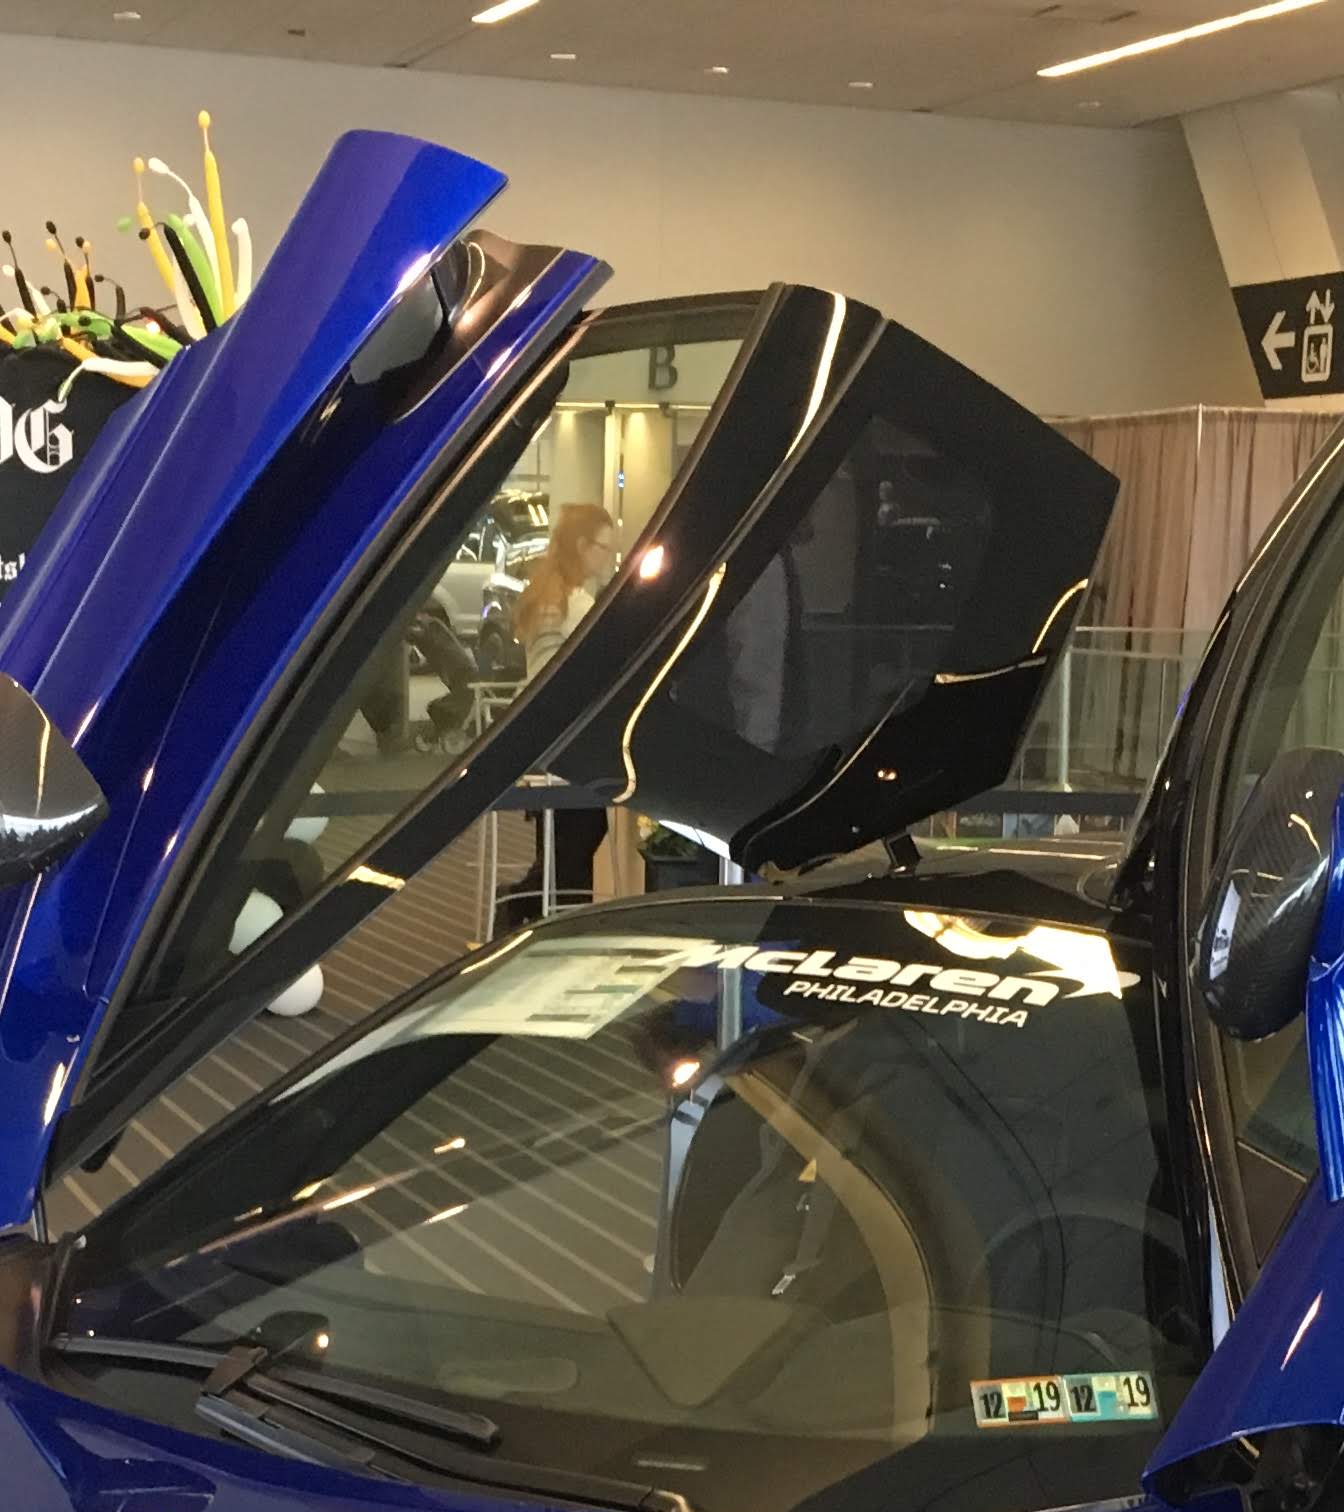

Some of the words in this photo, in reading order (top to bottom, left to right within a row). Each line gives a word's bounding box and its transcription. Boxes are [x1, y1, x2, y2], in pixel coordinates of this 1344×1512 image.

[648, 345, 678, 390] B
[644, 945, 1060, 1007] McLaren
[784, 980, 1029, 1028] PHILADELPHIA
[979, 1391, 1003, 1418] 12
[1033, 1381, 1061, 1412] 19
[1071, 1385, 1094, 1412] 12
[1123, 1376, 1152, 1408] 19
